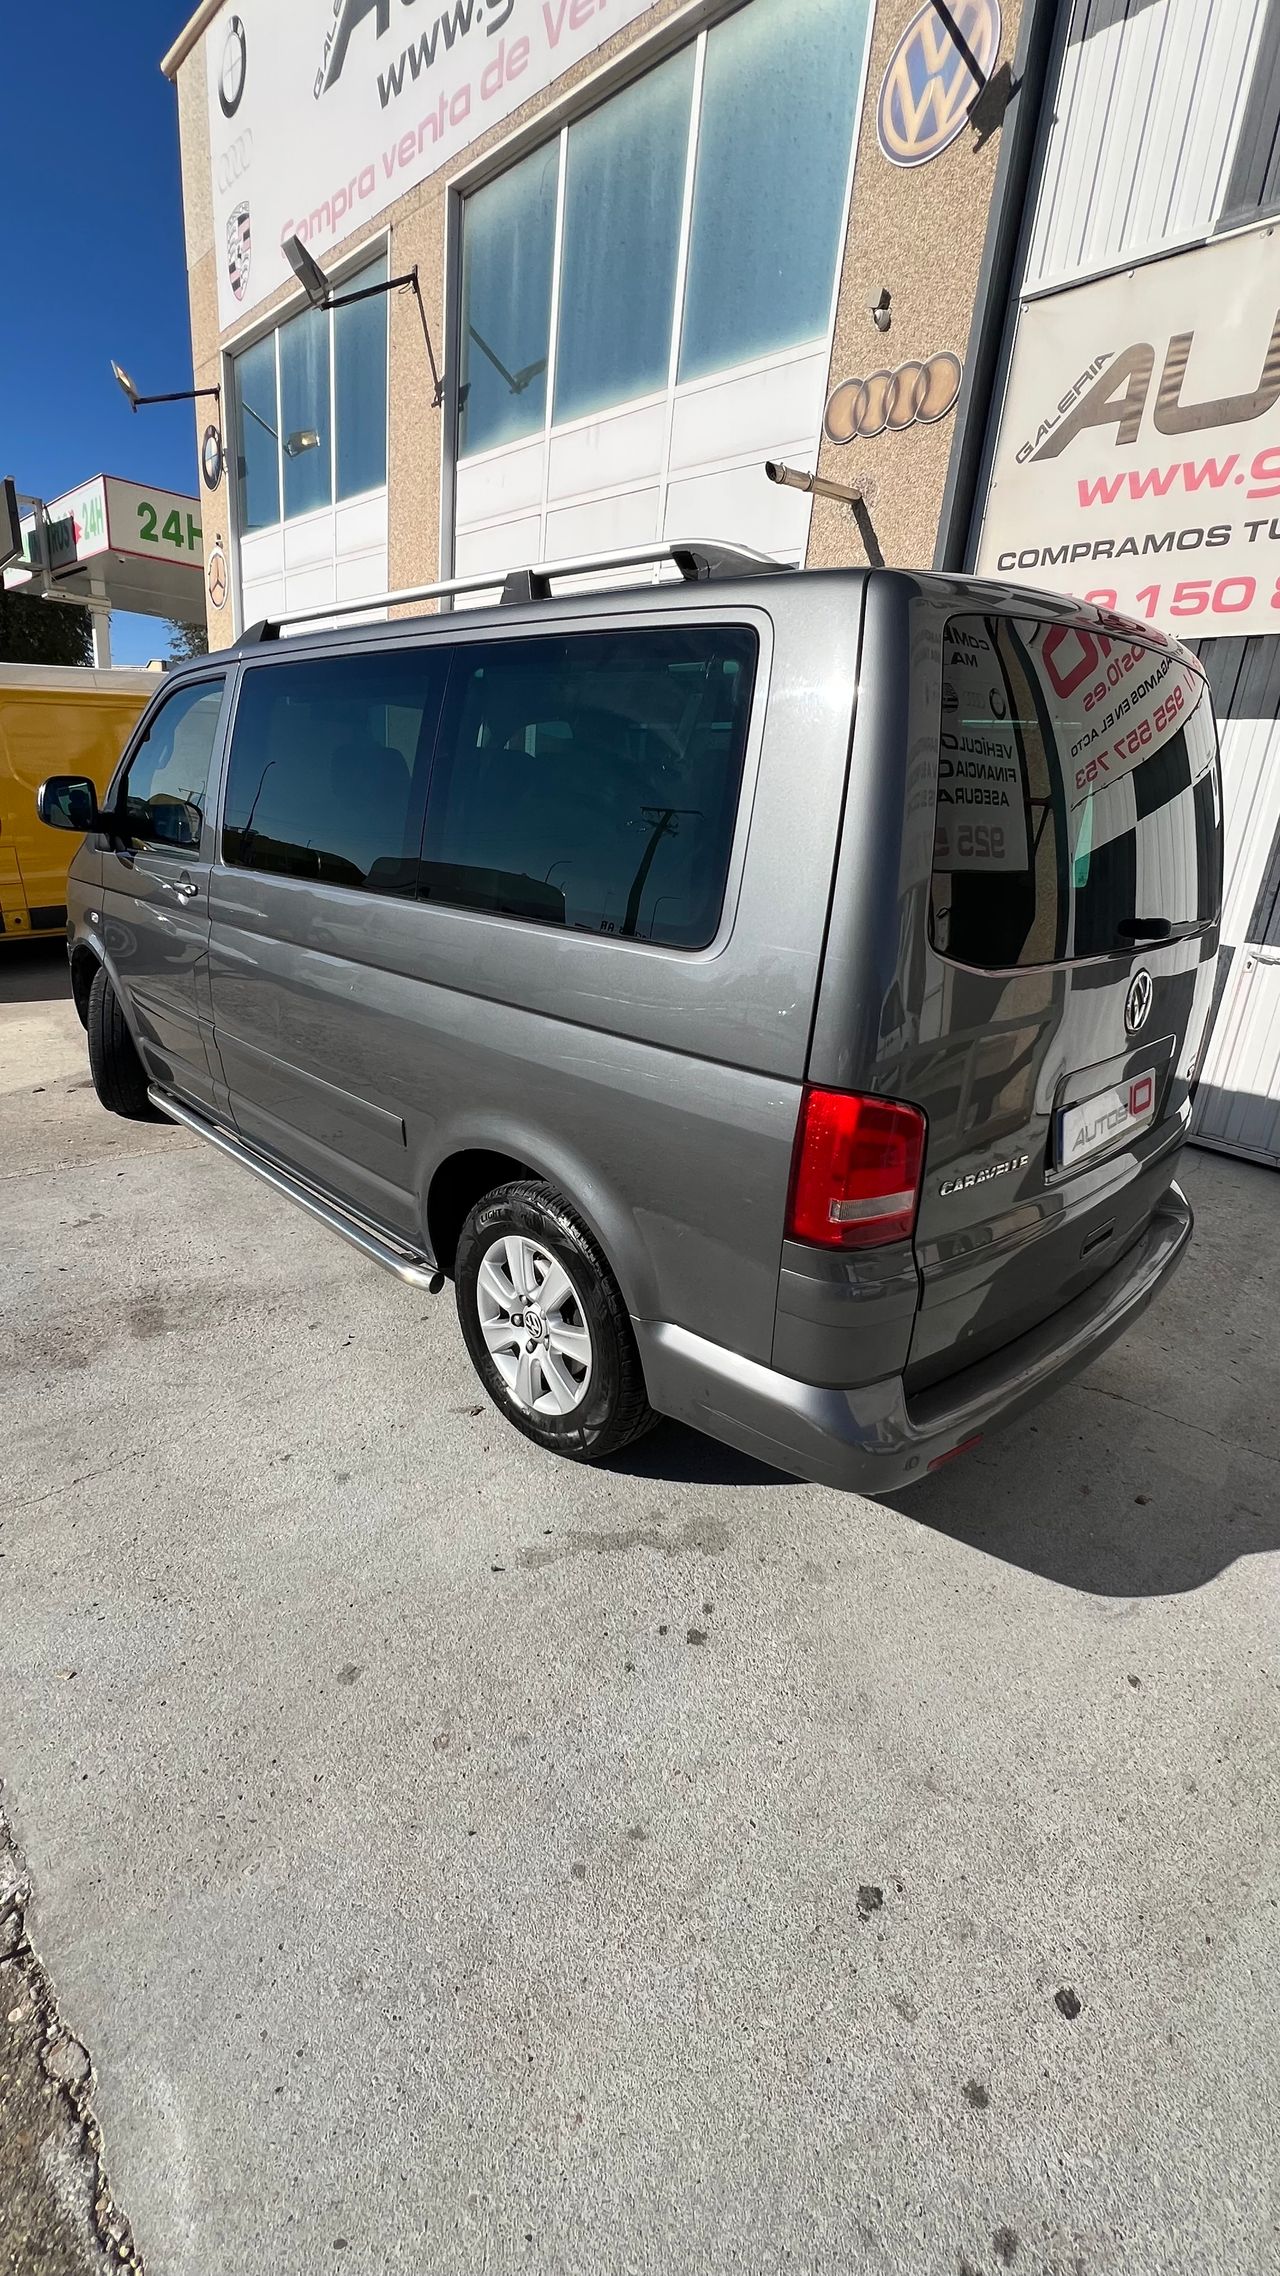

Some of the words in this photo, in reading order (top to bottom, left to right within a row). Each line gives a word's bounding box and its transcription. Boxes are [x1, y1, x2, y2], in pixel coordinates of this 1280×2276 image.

[382, 83, 471, 179] venta
[480, 36, 530, 101] de
[1015, 351, 1115, 464] GALERIA
[82, 495, 104, 541] 24H
[137, 501, 203, 551] 24H
[997, 525, 1232, 571] COMPRAMOS
[1136, 576, 1256, 618] 150
[939, 1155, 1029, 1197] CARAVELLE
